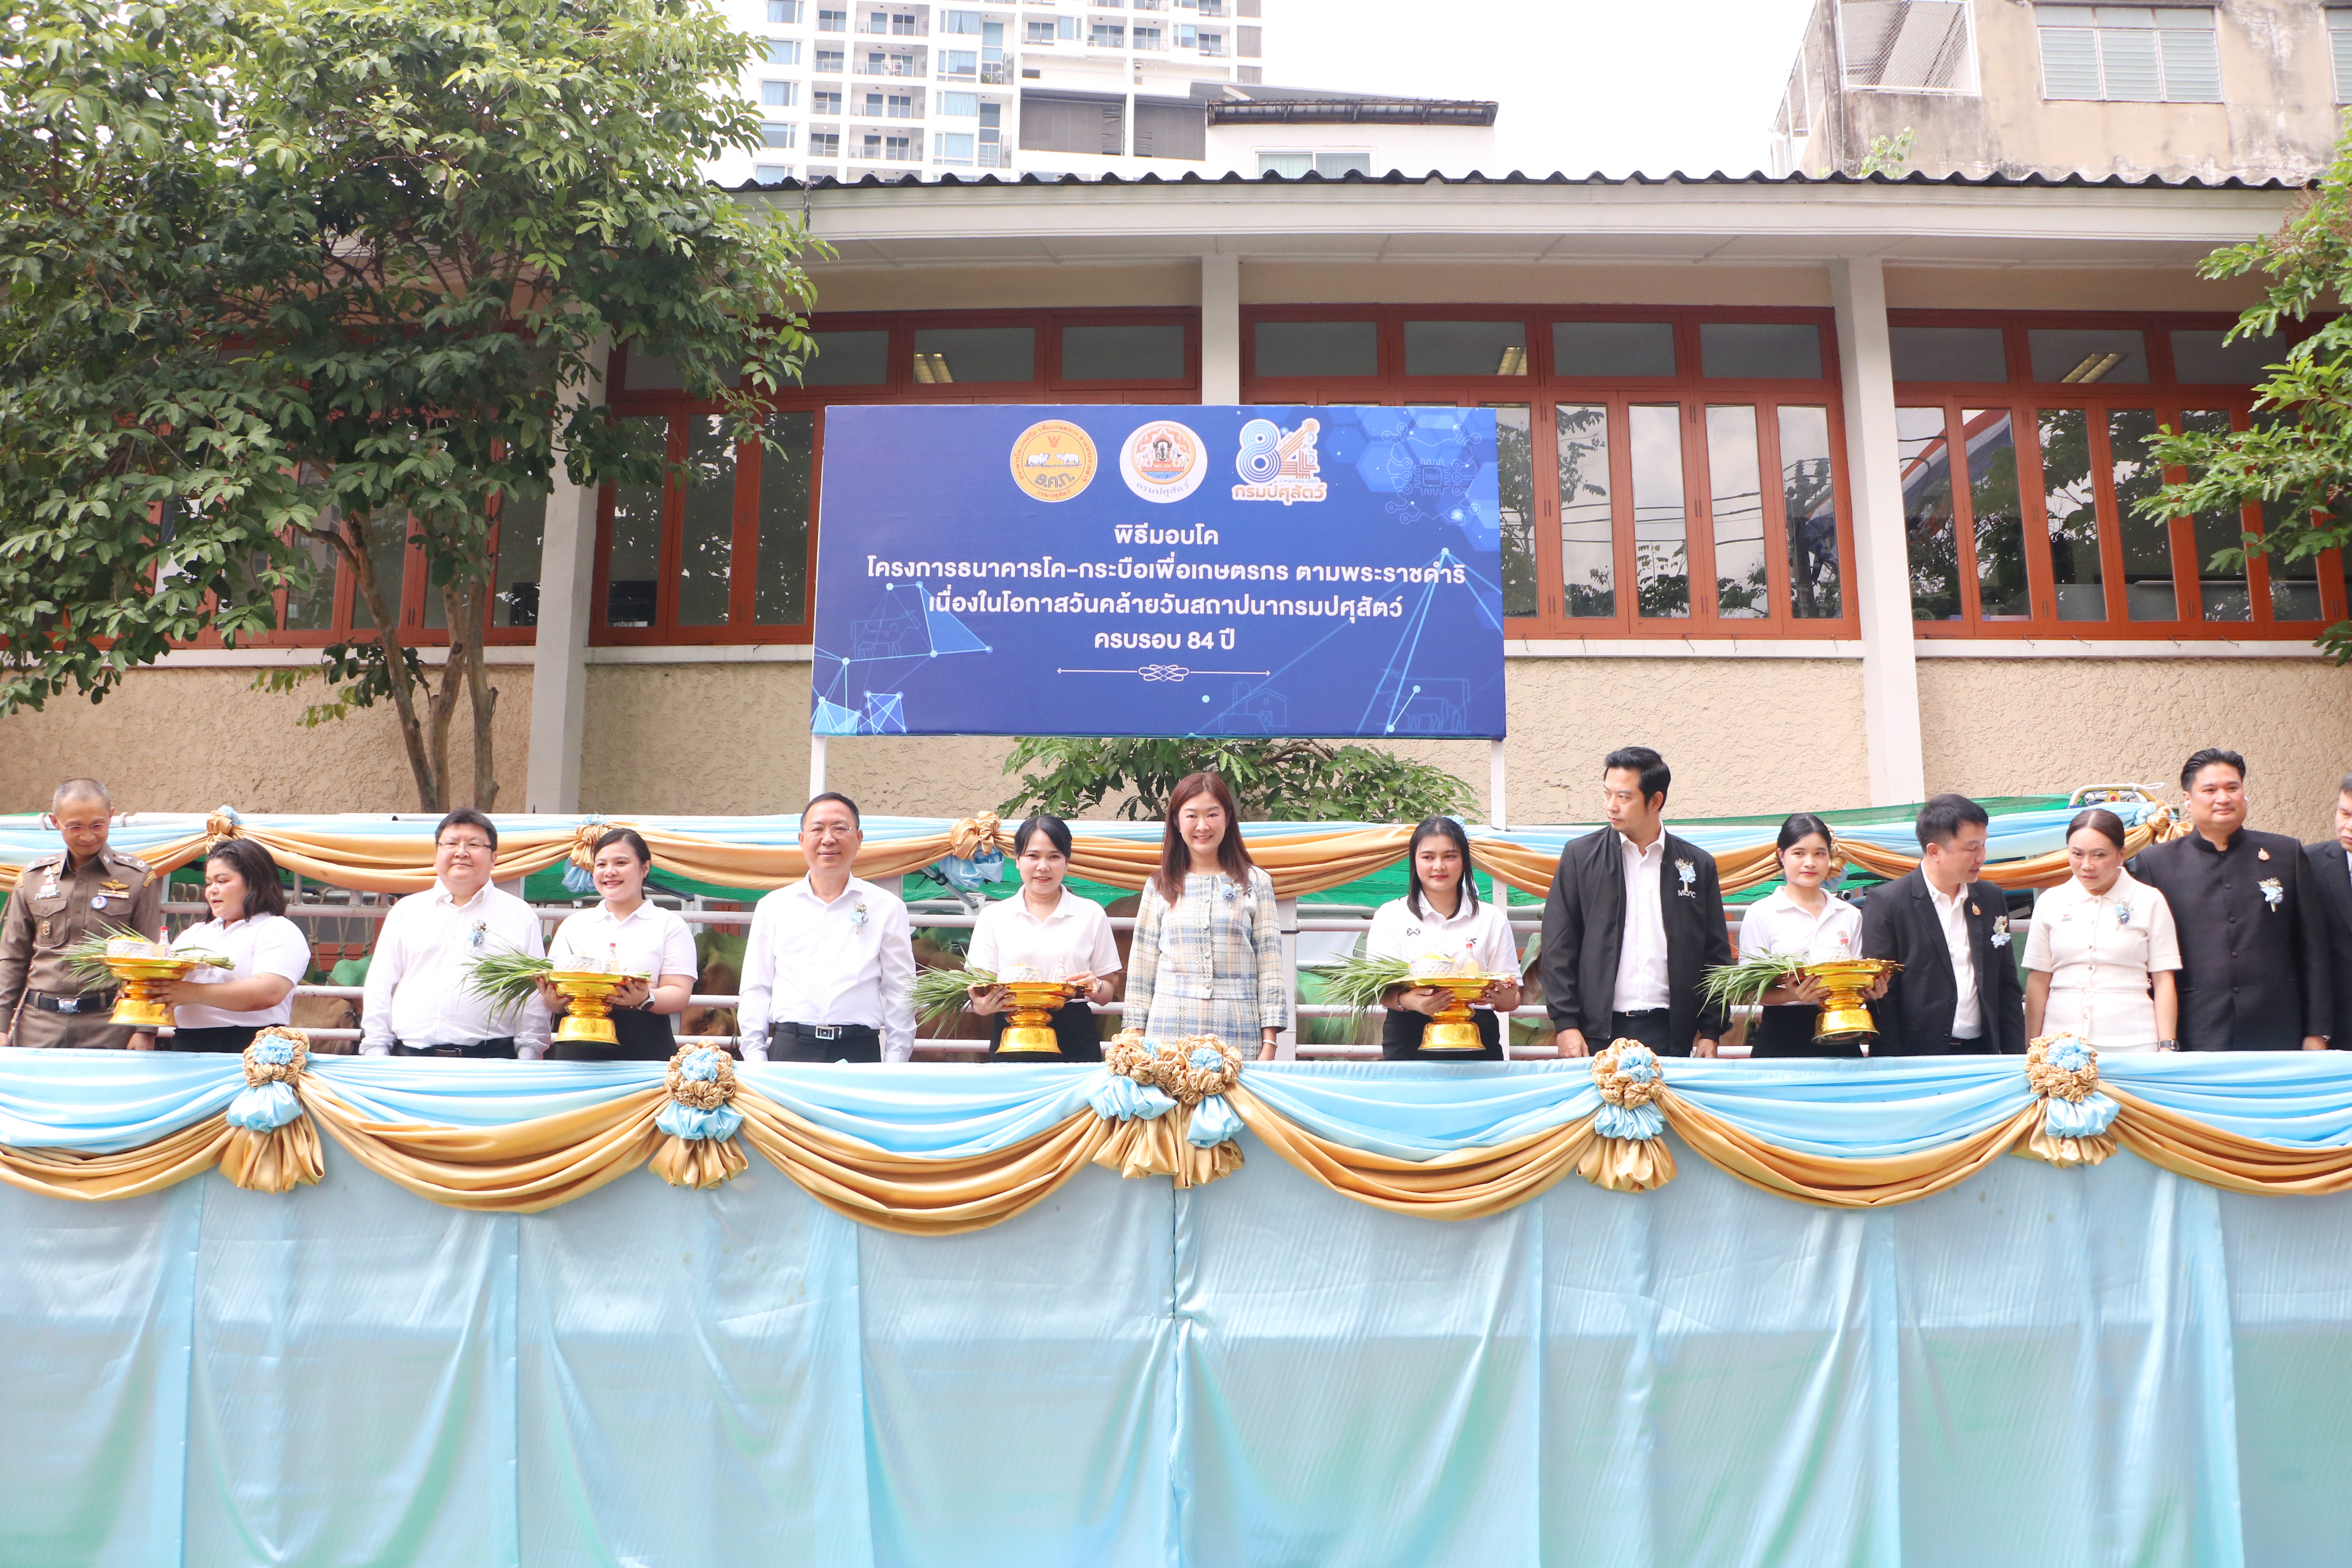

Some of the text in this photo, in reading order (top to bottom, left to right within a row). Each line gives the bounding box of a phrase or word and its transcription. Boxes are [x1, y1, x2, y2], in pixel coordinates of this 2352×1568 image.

[1239, 420, 1317, 483] 84
[1036, 488, 1071, 499] กรมปศุสัตว์
[1136, 479, 1189, 497] กรมปศุสัตว์
[1235, 485, 1324, 502] กรมปศุสัตว์
[1114, 522, 1219, 545] พิธีมอบโค
[867, 551, 1465, 583] โครงการธนาคารโค-กระบือเพื่อเกษตรกร ตามพระราชดำริ
[929, 584, 1403, 623] เนื่องในโอกาสวันคล้ายวันสถาปนากรมปศุสัตว์
[1095, 628, 1235, 650] ครบรอบ 84 ปี
